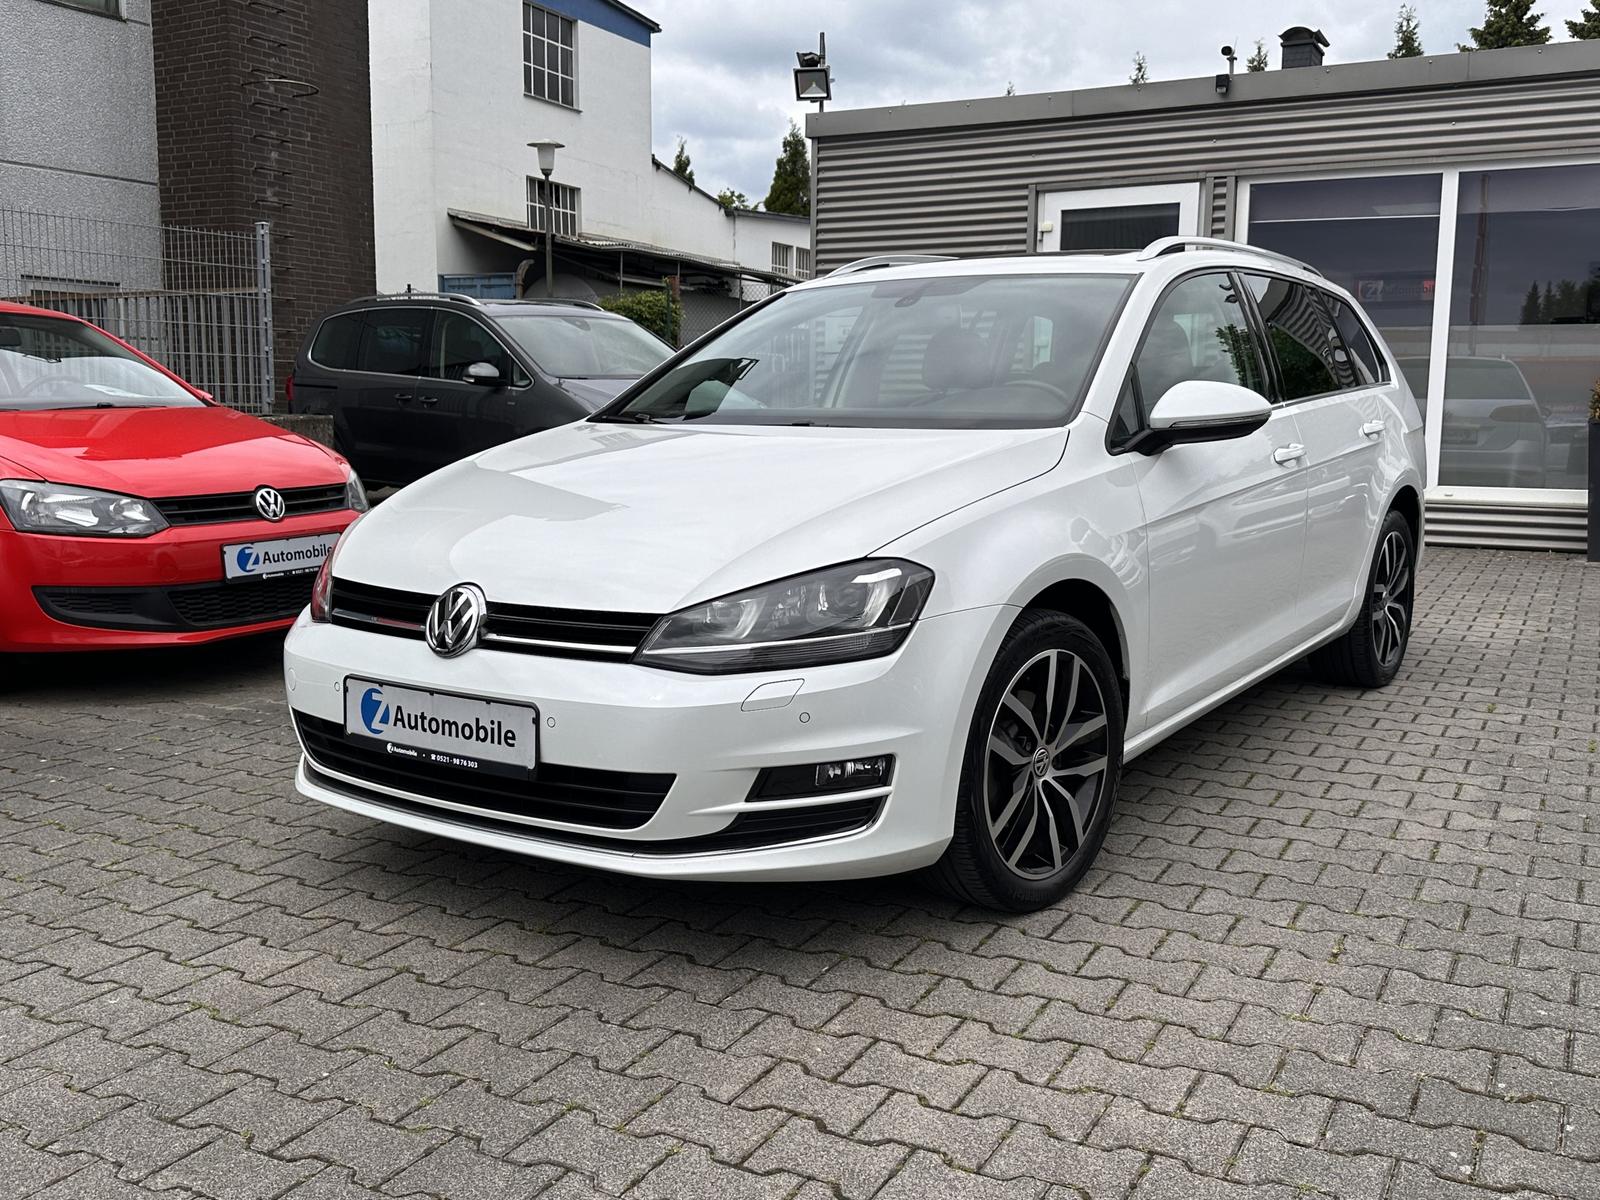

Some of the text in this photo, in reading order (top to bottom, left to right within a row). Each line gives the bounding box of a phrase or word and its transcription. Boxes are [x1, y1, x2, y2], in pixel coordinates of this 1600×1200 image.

[256, 488, 285, 520] VW
[427, 586, 480, 656] VW
[393, 705, 517, 748] Automobile
